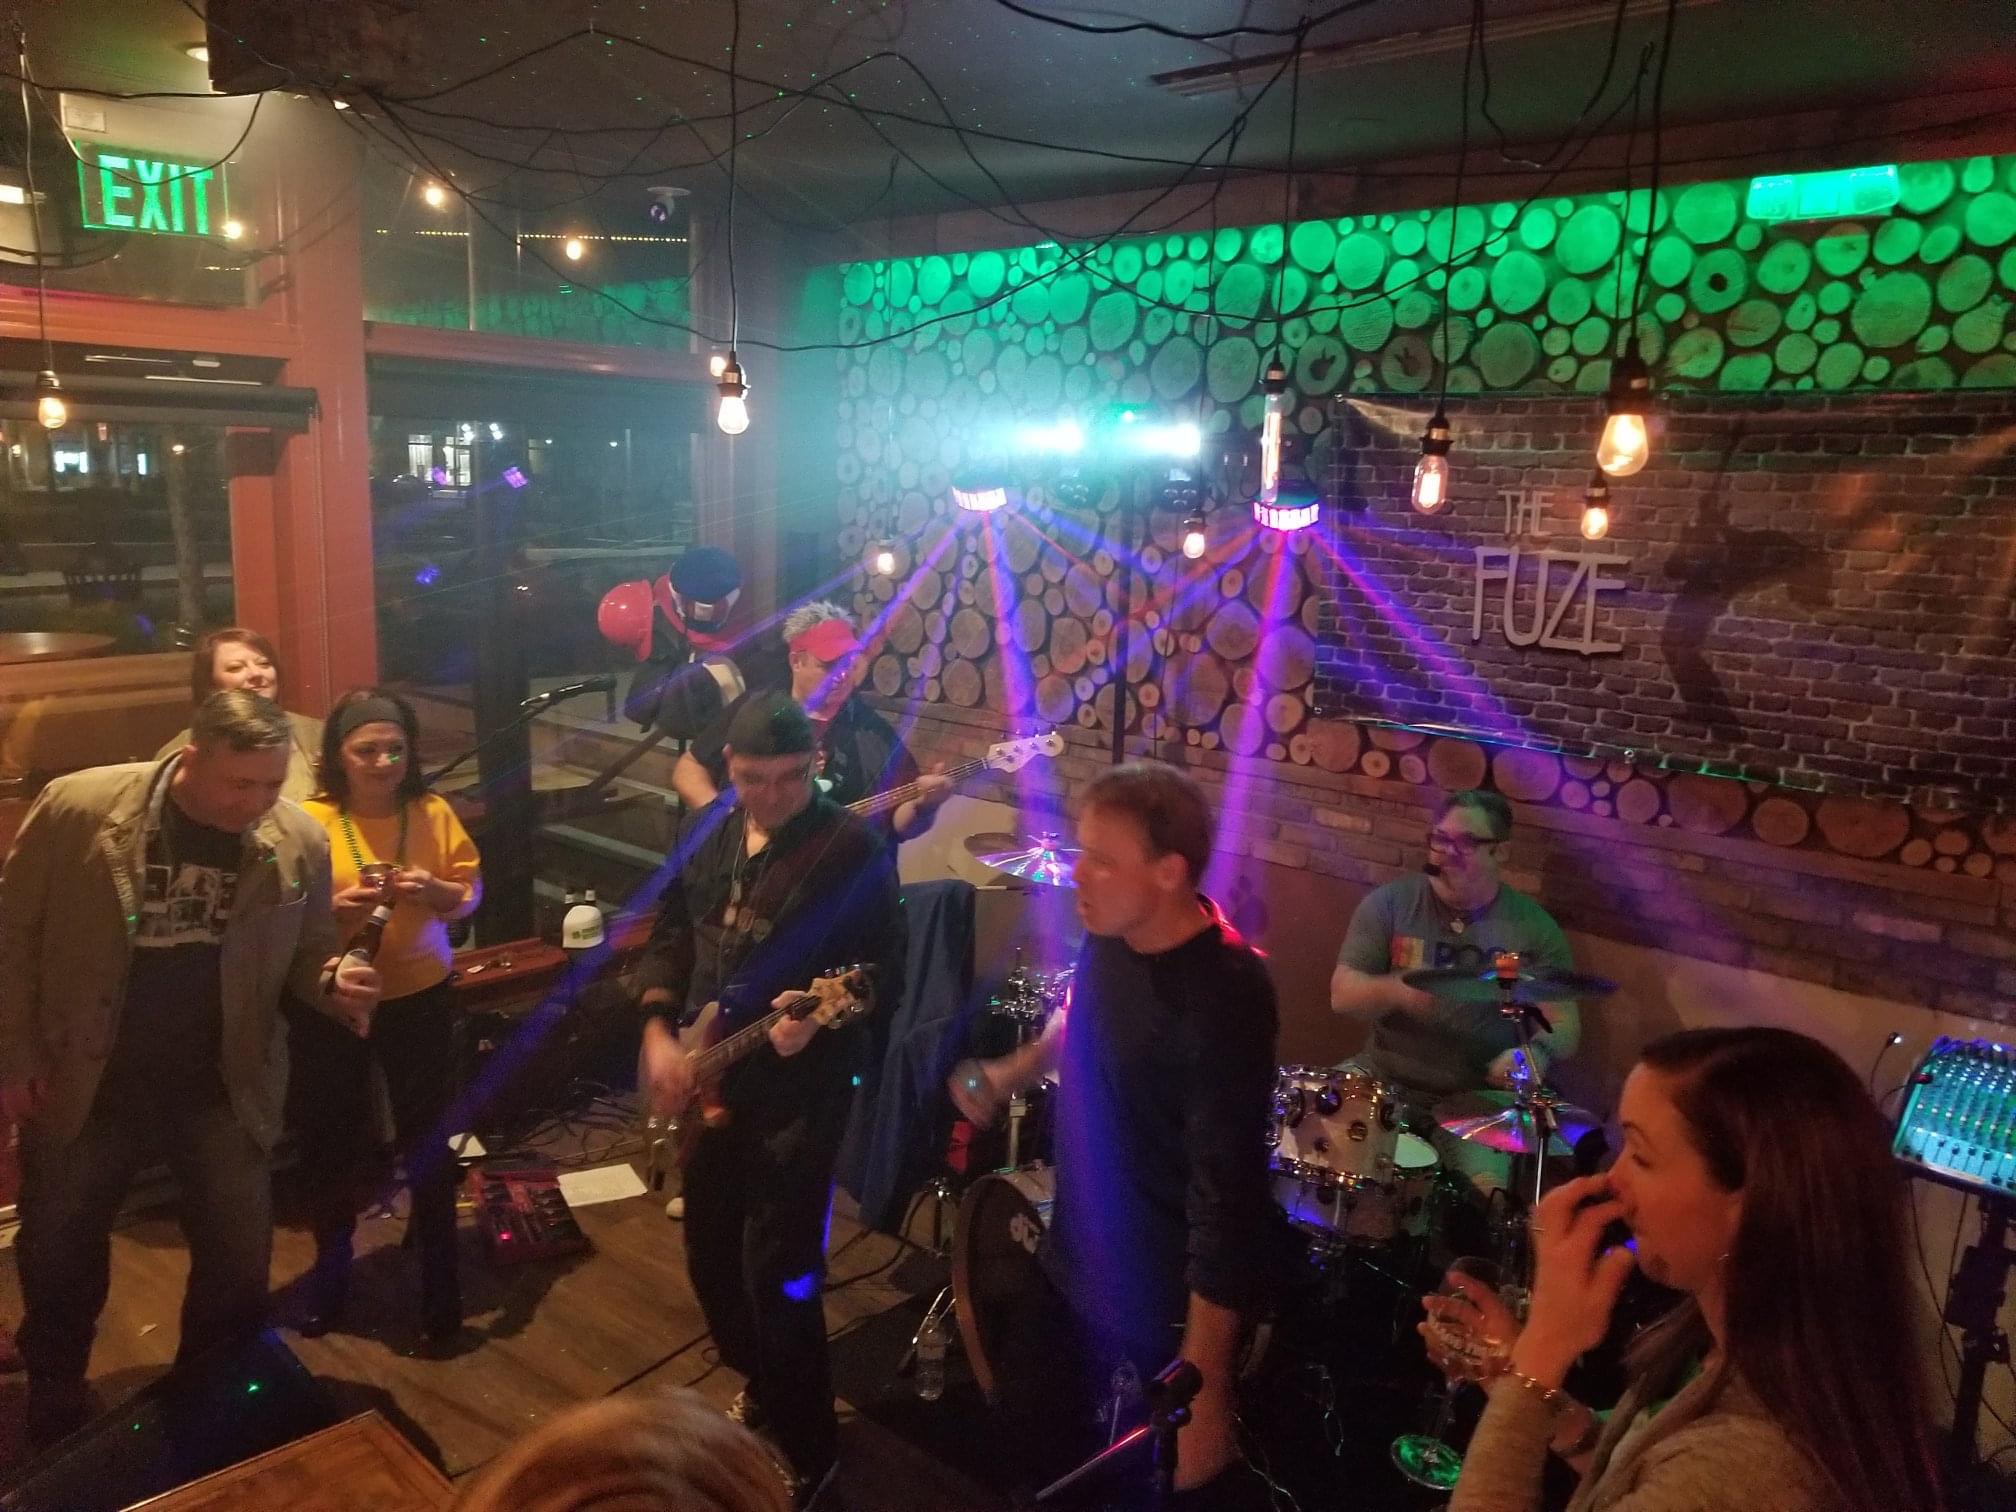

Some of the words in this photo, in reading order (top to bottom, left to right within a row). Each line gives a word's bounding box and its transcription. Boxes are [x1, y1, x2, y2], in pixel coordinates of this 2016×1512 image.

[98, 154, 214, 235] EXIT
[1497, 490, 1555, 536] THE
[1472, 545, 1632, 655] FUZE
